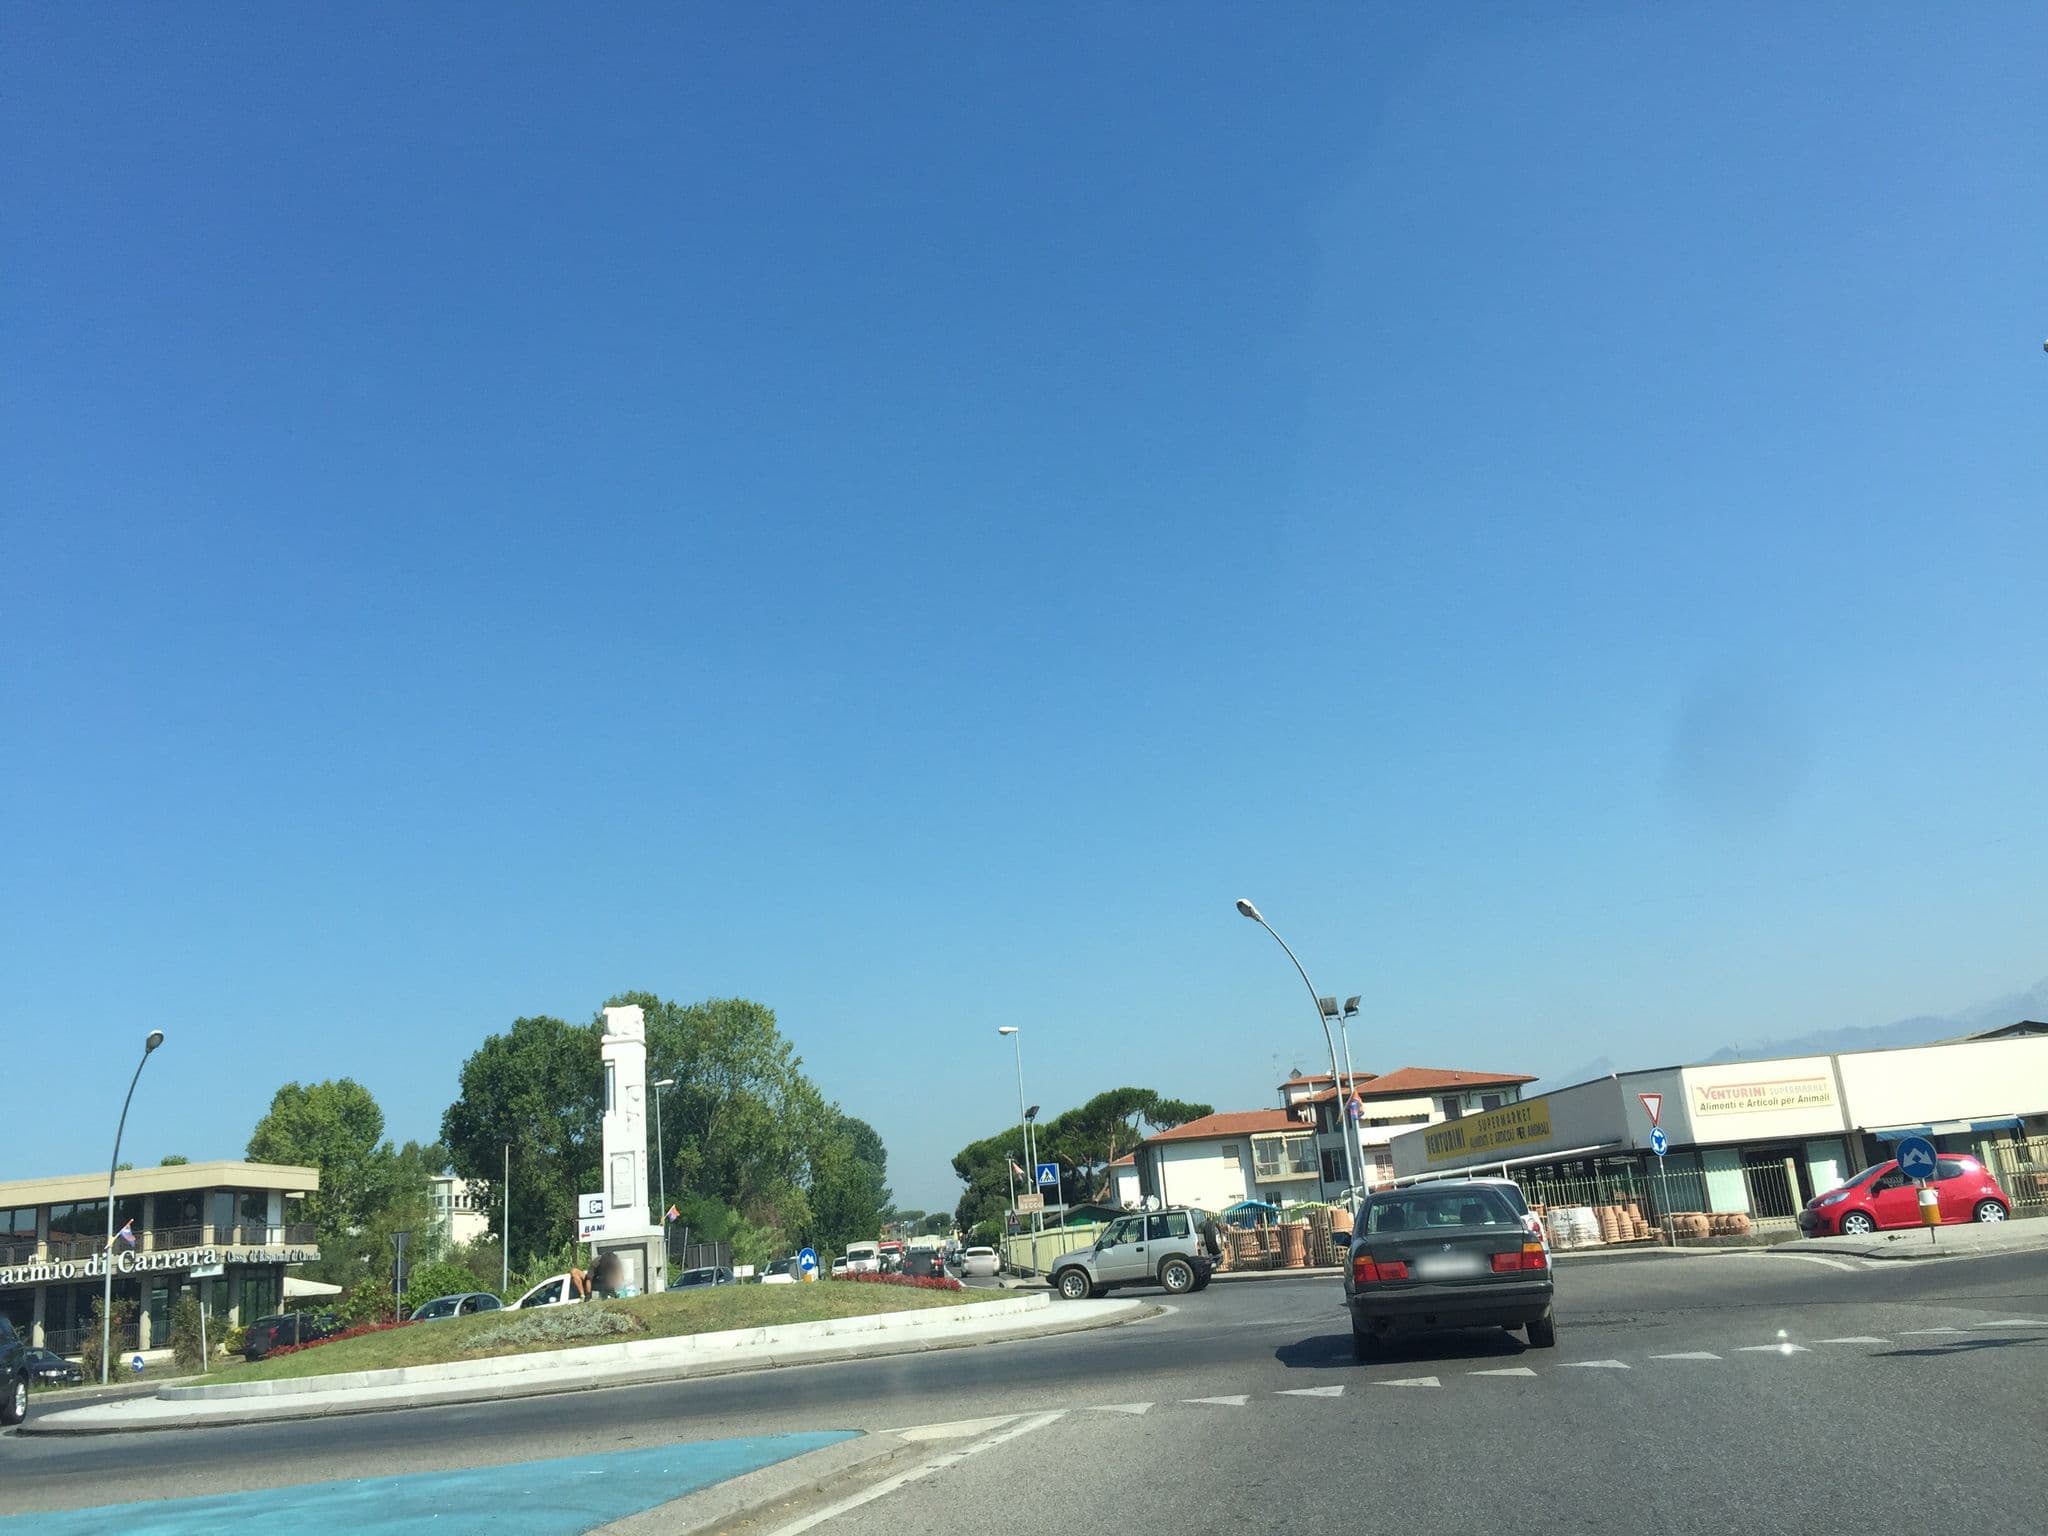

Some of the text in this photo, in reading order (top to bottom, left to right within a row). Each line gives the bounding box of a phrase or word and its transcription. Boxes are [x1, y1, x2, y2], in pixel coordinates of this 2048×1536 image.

[1700, 1101, 1737, 1111] Alimenti
[1747, 1097, 1779, 1108] Articoli
[1780, 1097, 1795, 1107] per
[1797, 1092, 1830, 1103] Animali
[1478, 1107, 1531, 1132] SUPERMARKET
[0, 1249, 216, 1285] armio di Carrara
